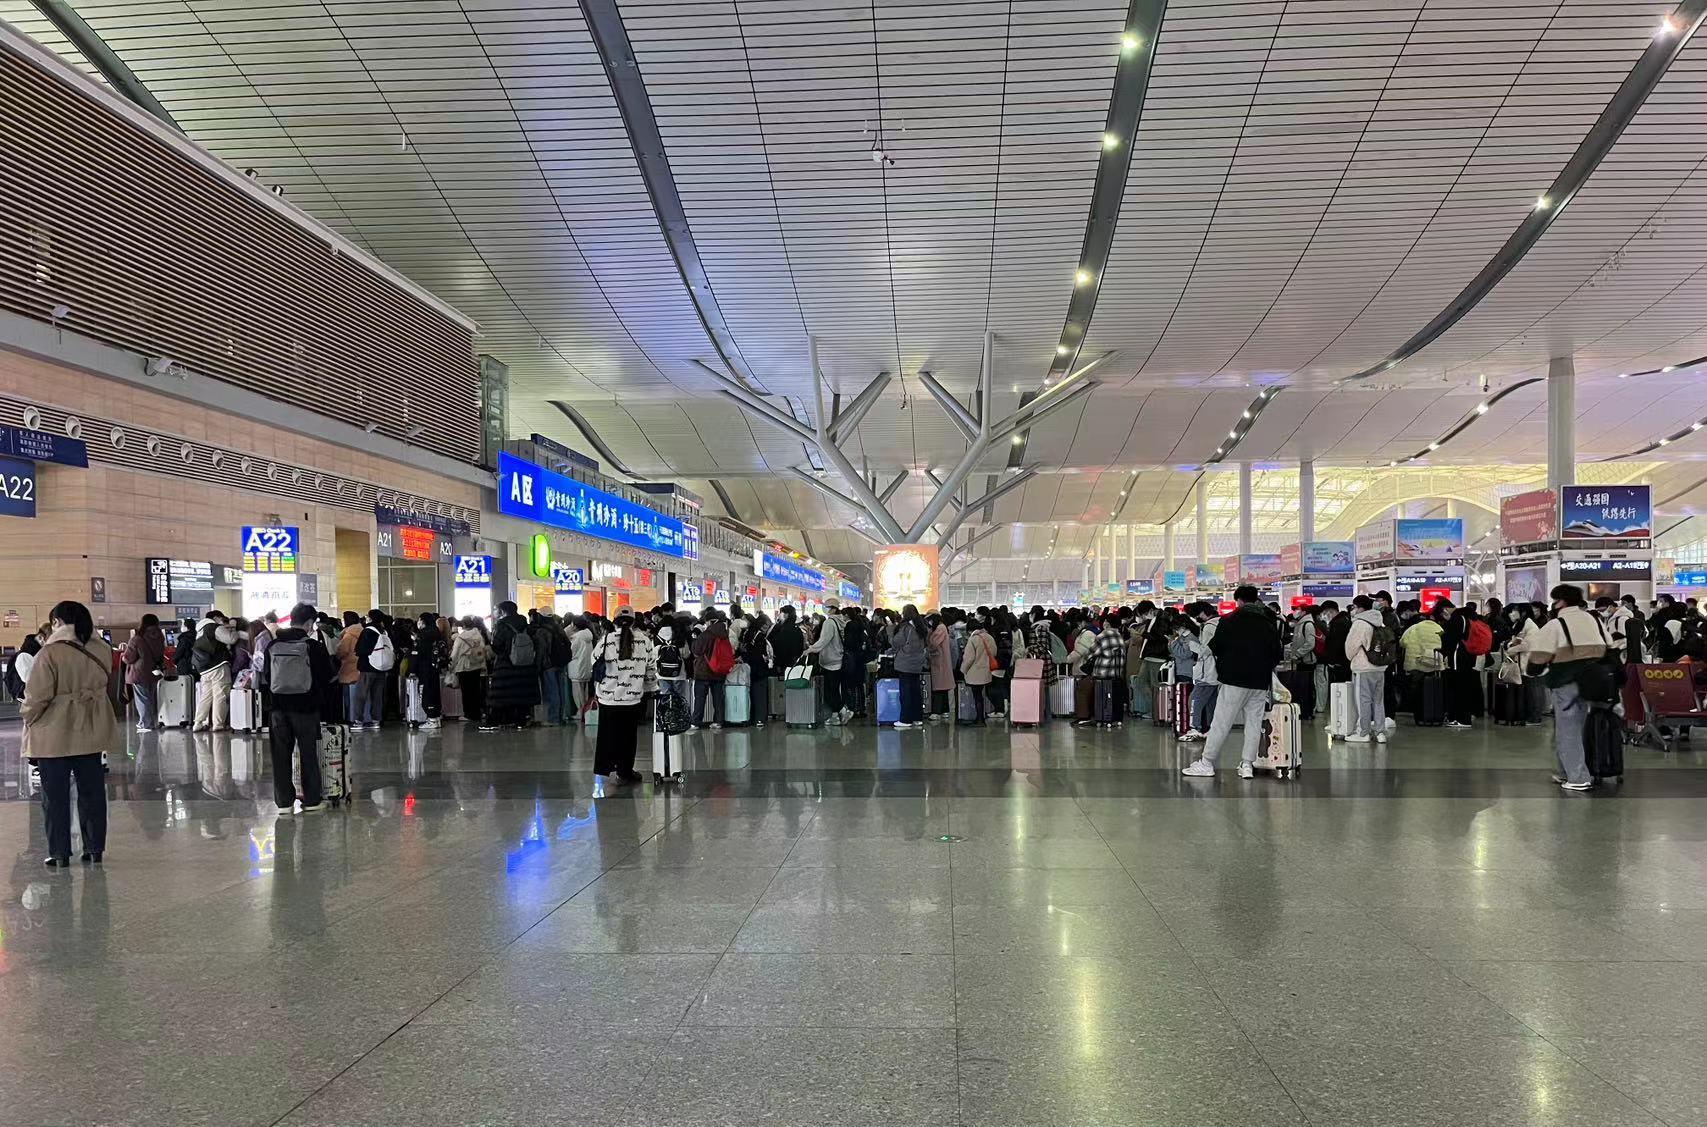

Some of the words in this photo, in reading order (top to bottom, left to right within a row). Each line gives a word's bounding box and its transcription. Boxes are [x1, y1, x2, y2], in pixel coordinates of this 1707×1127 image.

[0, 473, 34, 501] A22
[511, 471, 534, 507] A区
[1575, 492, 1610, 507] 交通强国
[1601, 506, 1636, 520] 铁路先行
[245, 532, 292, 552] A22
[377, 531, 392, 548] A21
[440, 541, 452, 556] A20
[457, 559, 486, 574] A21
[556, 571, 580, 583] A20
